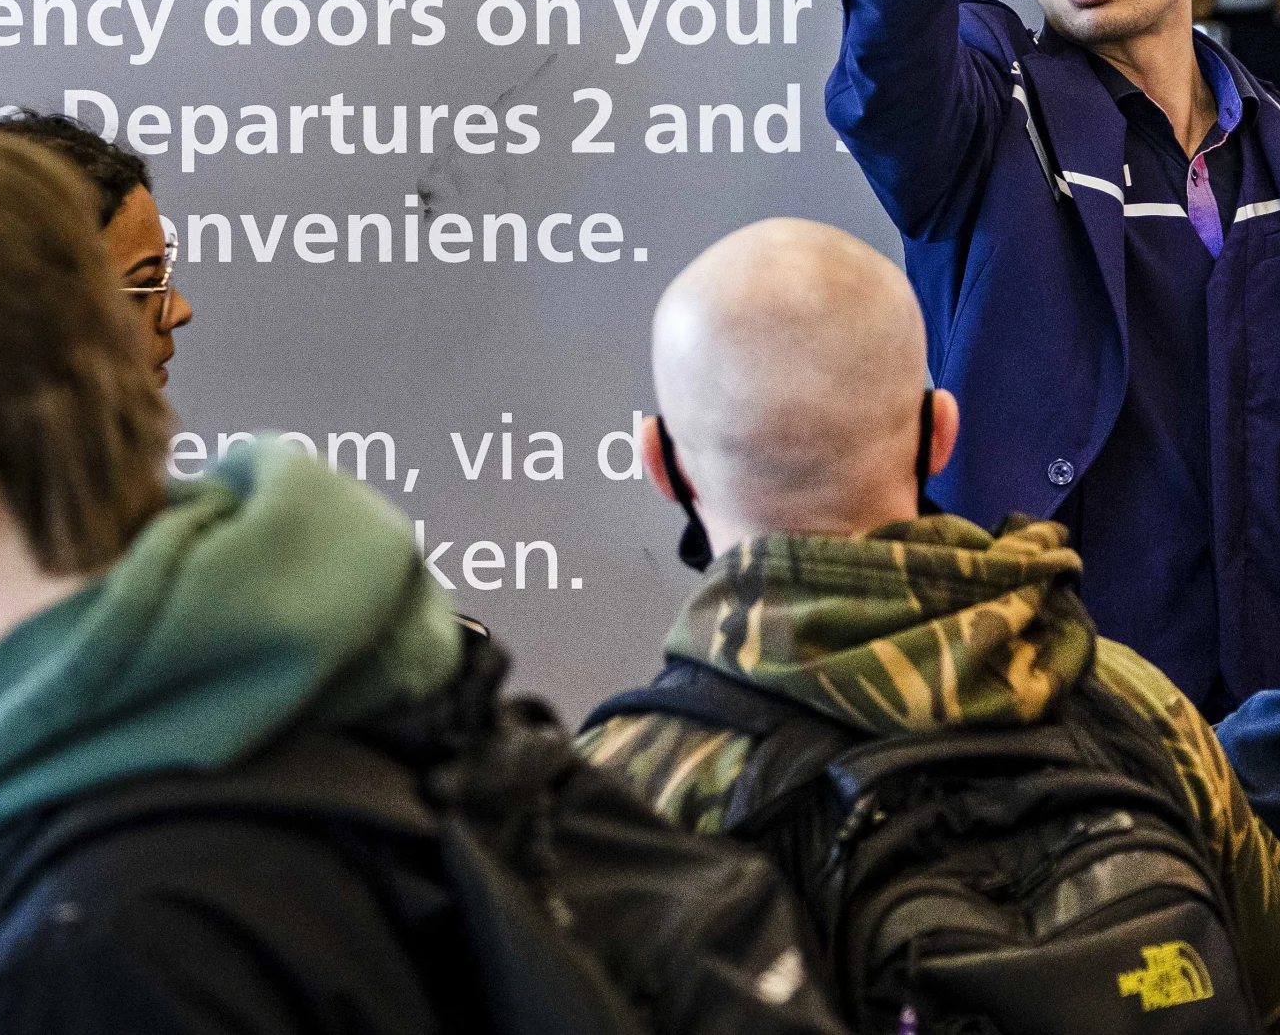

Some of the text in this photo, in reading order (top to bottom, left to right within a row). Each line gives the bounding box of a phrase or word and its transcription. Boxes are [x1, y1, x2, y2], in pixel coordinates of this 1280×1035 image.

[63, 89, 540, 173] Departures
[572, 88, 615, 153] 2
[644, 83, 801, 154] and
[451, 412, 564, 481] via
[597, 411, 642, 481] d
